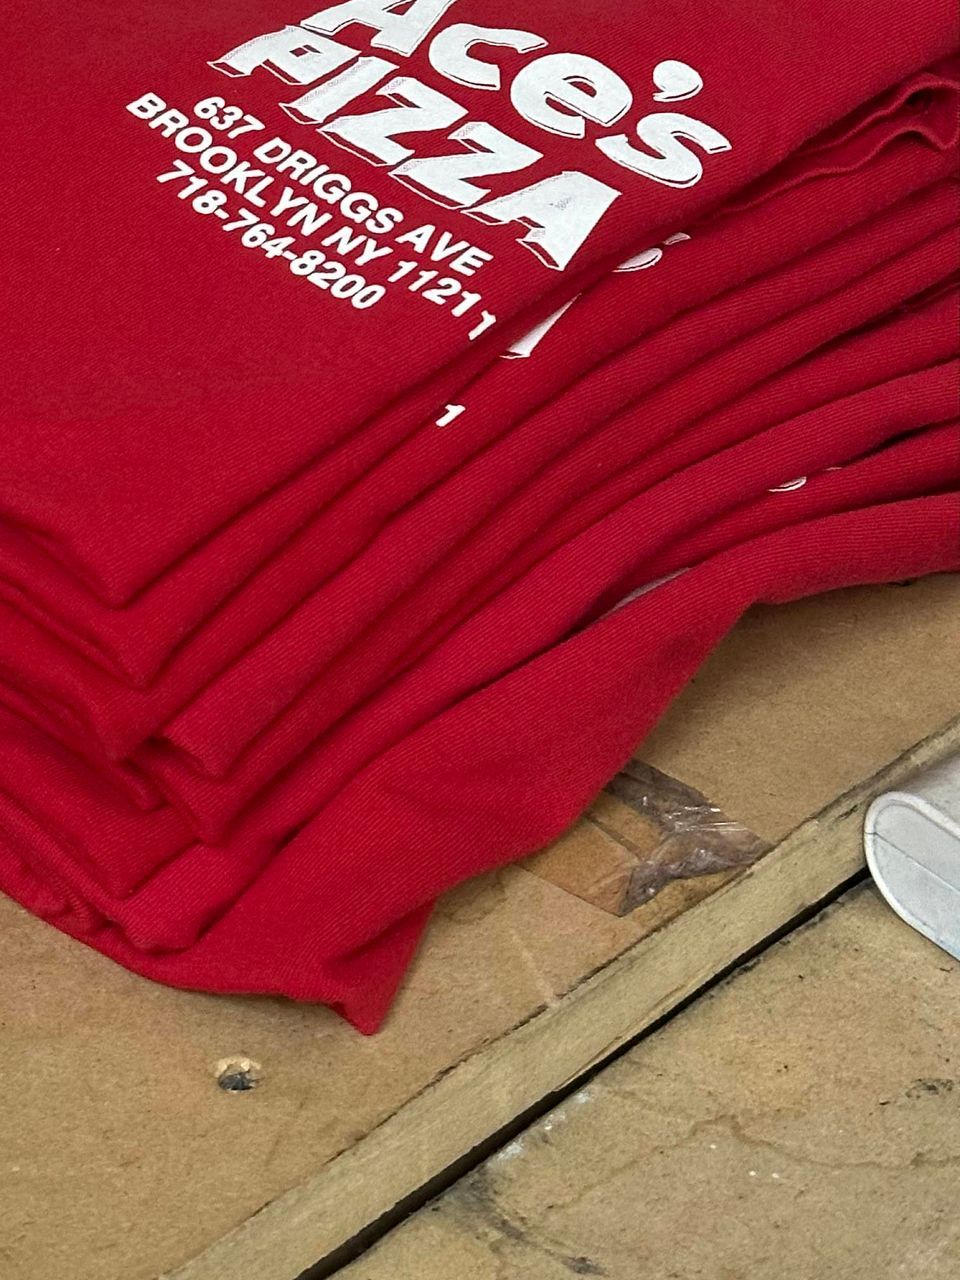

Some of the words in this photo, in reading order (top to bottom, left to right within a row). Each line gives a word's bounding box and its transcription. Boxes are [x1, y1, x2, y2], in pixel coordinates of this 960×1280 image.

[126, 92, 333, 236] BROOKLYN
[321, 226, 394, 266] NY
[387, 260, 496, 340] 11211
[156, 160, 386, 309] 718-764-8200
[193, 96, 266, 139] 637
[253, 137, 404, 233] DRIGGS
[395, 224, 494, 276] AVE
[207, 25, 622, 272] PIZZA
